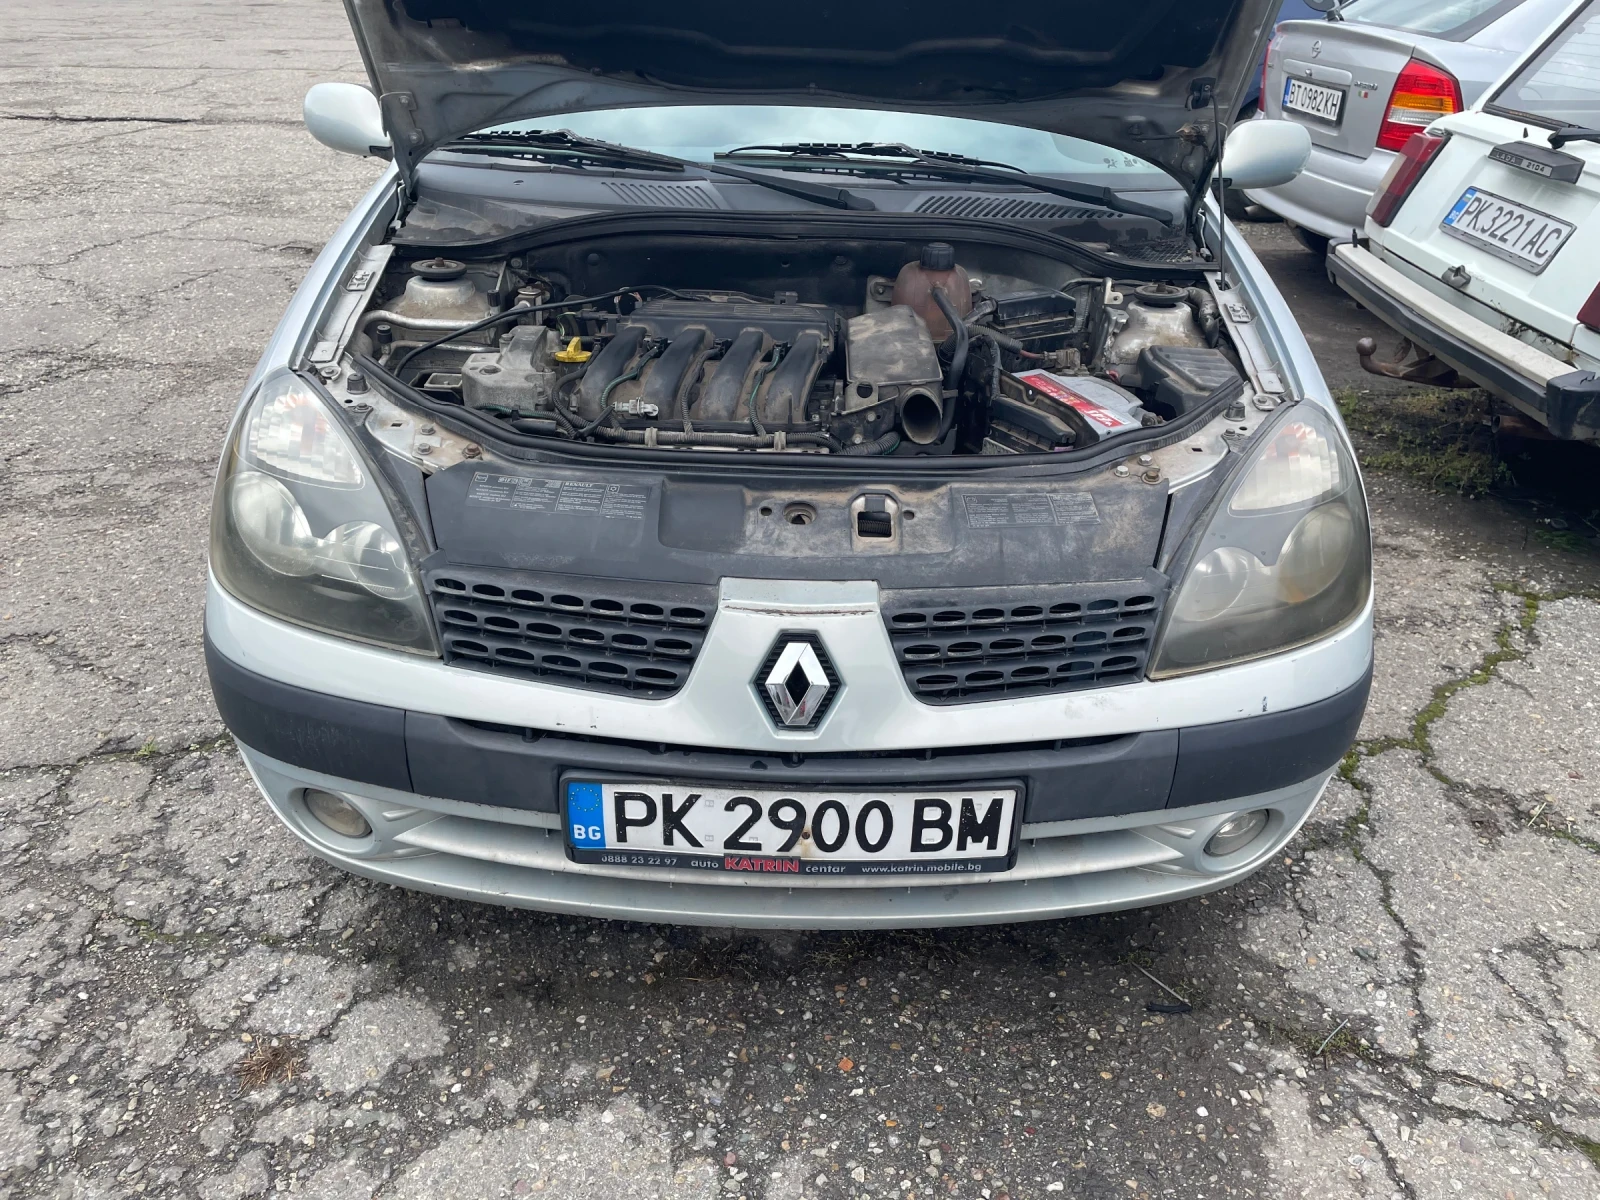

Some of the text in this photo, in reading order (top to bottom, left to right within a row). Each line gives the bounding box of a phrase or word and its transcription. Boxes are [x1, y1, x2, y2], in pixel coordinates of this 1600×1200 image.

[1289, 83, 1340, 116] BT 0982 KH
[1495, 151, 1546, 172] LADA 2104
[1456, 196, 1563, 259] PK 3221 AC
[573, 824, 601, 840] BG
[614, 791, 1004, 853] PK 2900 BM
[601, 854, 982, 873] 0888 23 22 97 auto KATRIN centar www.katrin.mobile.bg
